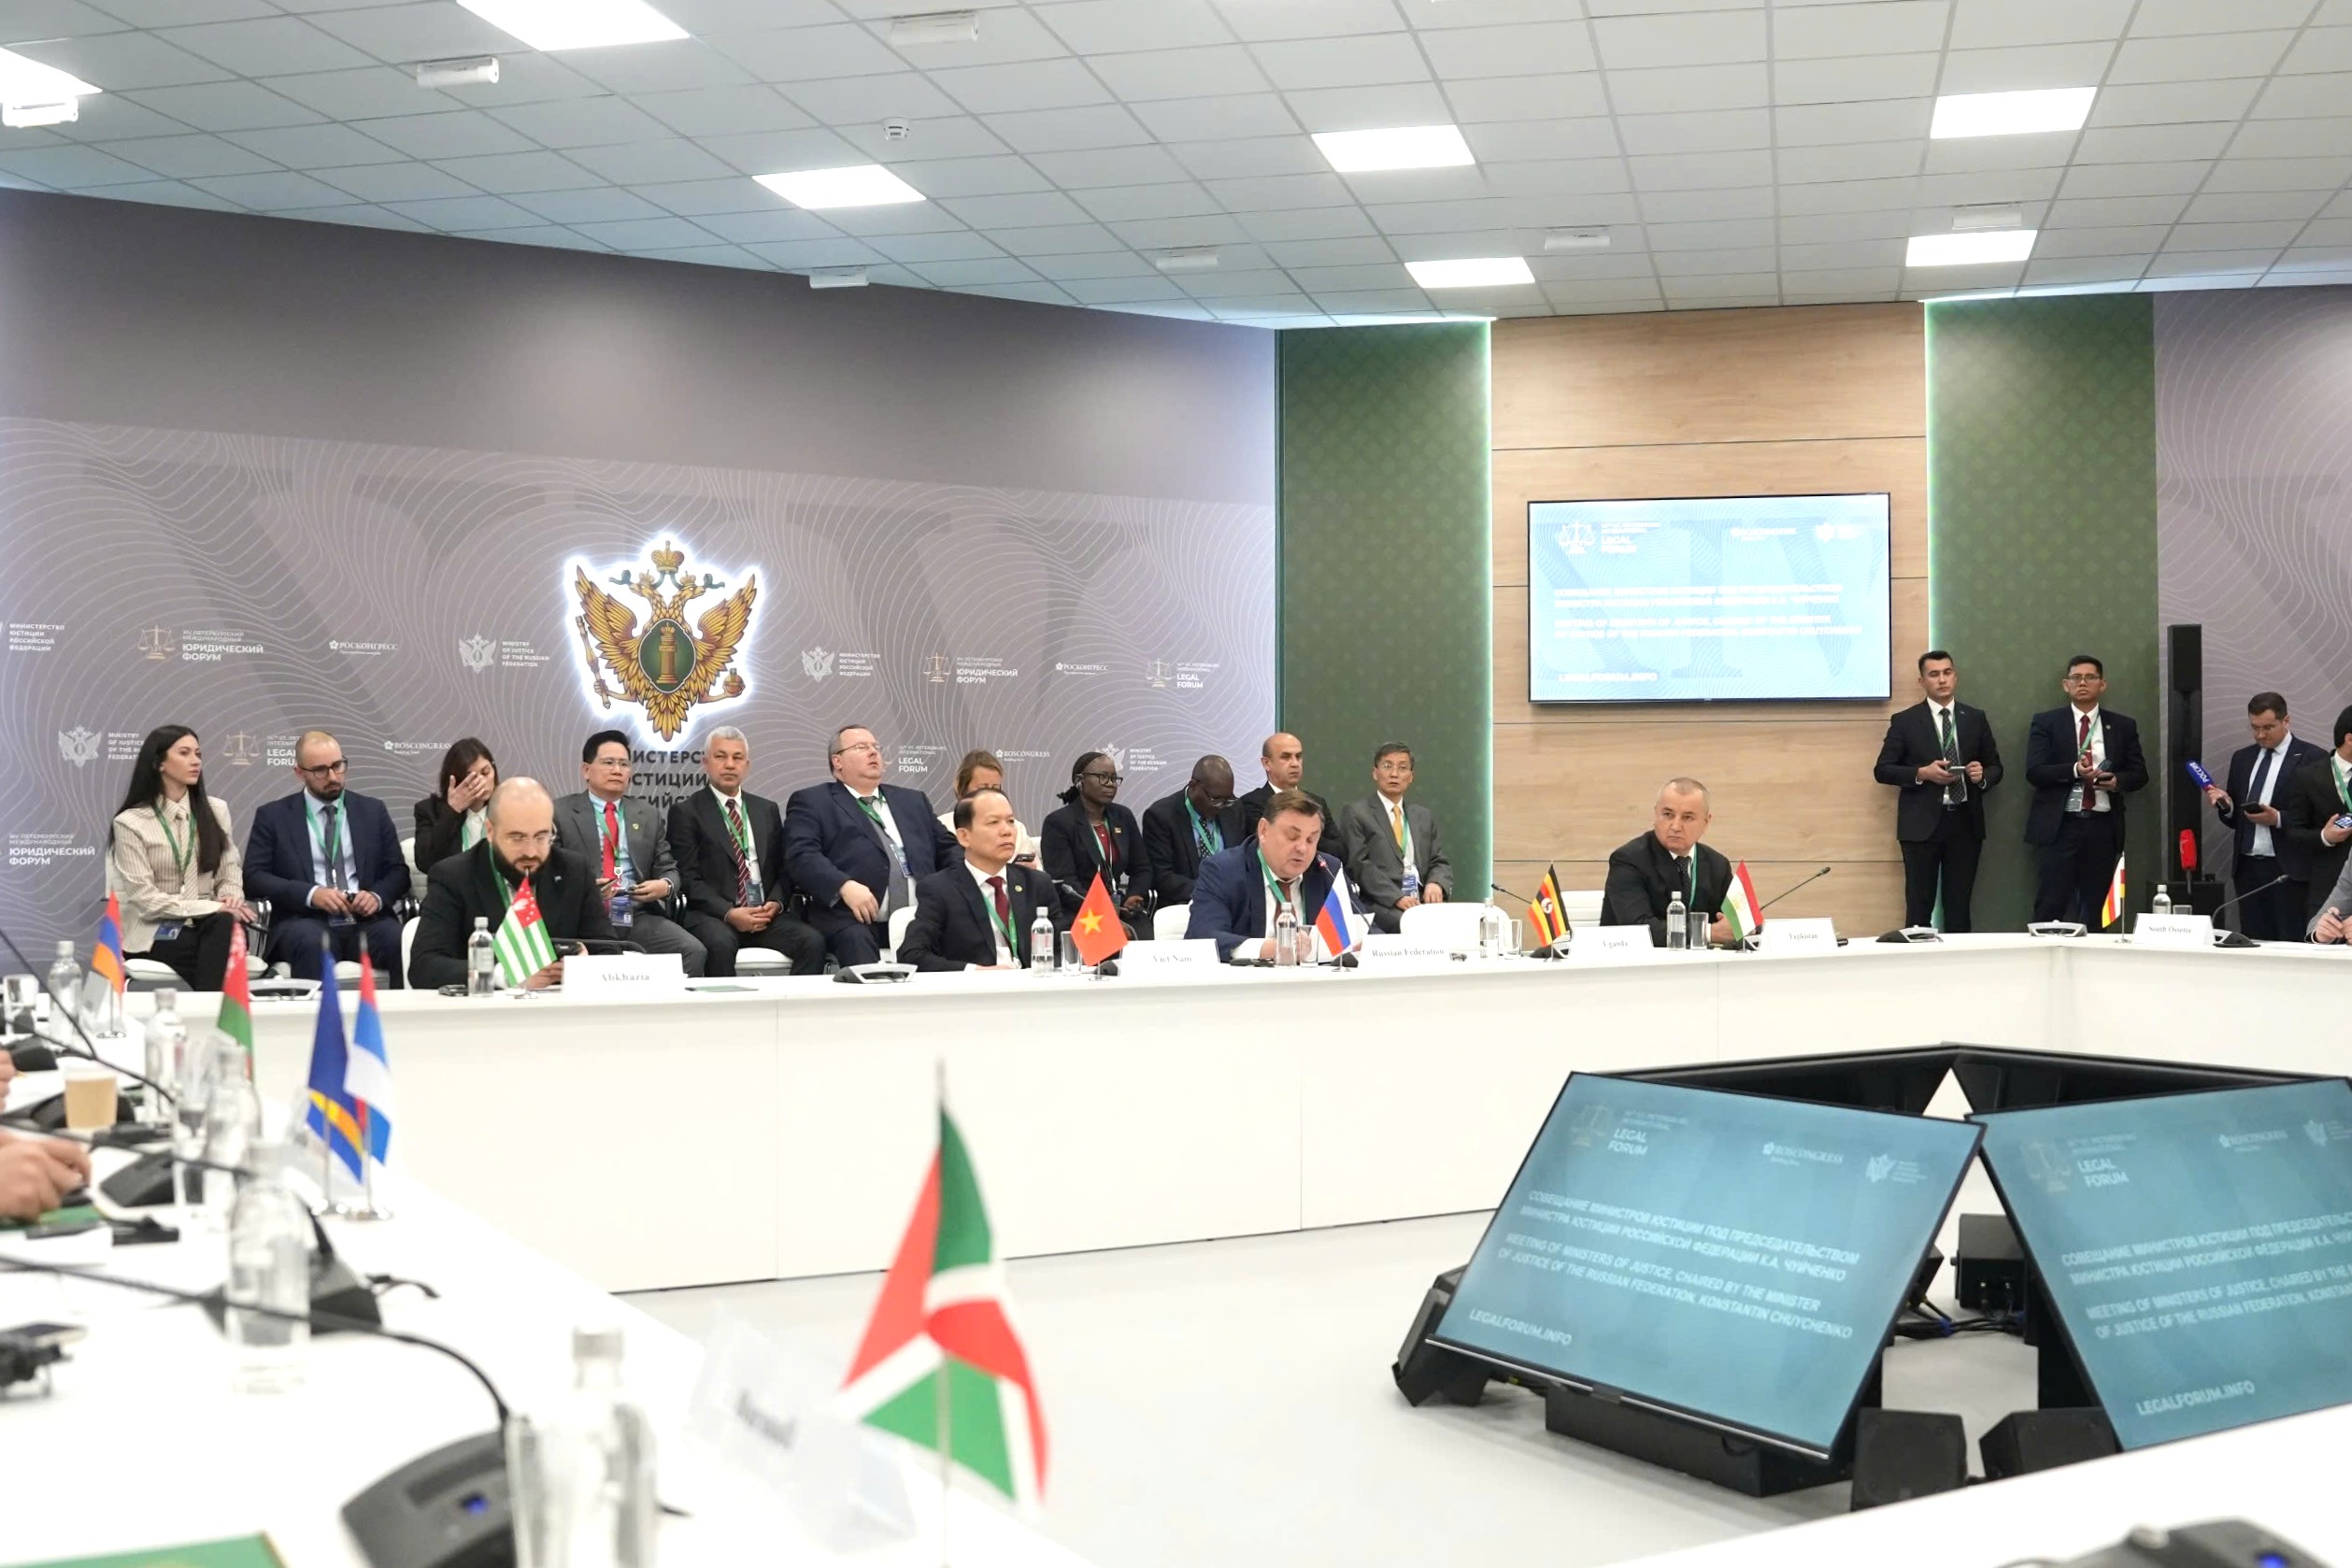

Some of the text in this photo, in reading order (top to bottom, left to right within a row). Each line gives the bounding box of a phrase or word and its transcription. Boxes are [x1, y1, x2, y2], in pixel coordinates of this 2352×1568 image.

[182, 643, 264, 653] ЮРИДИЧЕСКИЙ
[339, 642, 398, 650] РОСКОНГРЕСС
[182, 653, 221, 662] ФОРУМ
[957, 668, 1019, 677] ЮРИДИЧЕСКИЙ
[1176, 673, 1200, 681] LEGAL
[267, 758, 297, 766] FORU
[628, 773, 707, 788] СТИЦИИ
[9, 846, 95, 856] ЮРИДИЧЕСКИЙ
[9, 857, 50, 865] ФОРУМ
[1613, 1128, 1647, 1143] LEGAL
[1607, 1140, 1648, 1155] FORUM
[2076, 1158, 2117, 1173] LEGAL
[2084, 1171, 2130, 1188] FORUM
[1703, 1225, 1730, 1242] ПОД
[1728, 1230, 1860, 1265] ПРЕДСЕДАТЕЛЬСТВОМ
[1505, 1233, 1548, 1251] MEETING
[1547, 1241, 1563, 1254] OF
[1614, 1257, 1631, 1270] OF
[1674, 1270, 1724, 1290] CHAIRED
[1722, 1281, 1744, 1294] BY
[1742, 1284, 1766, 1301] THE
[1764, 1289, 1822, 1313] MINISTER
[1498, 1247, 1512, 1260] OF
[1511, 1250, 1551, 1269] JUSTICE
[1550, 1260, 1566, 1272] OF
[1565, 1262, 1587, 1277] THE
[1585, 1267, 1632, 1289] RUSSIAN
[1697, 1295, 1770, 1321] KONSTANTIN
[1769, 1310, 1854, 1339] CHUYCHENKO
[2135, 1297, 2150, 1312] OF
[2208, 1286, 2222, 1299] OF
[1469, 1307, 1572, 1346] LEGALFORUM.INFO
[2095, 1324, 2111, 1340] OF
[2113, 1316, 2159, 1337] JUSTICE
[2158, 1314, 2173, 1329] OF
[2174, 1308, 2199, 1325] THE
[2135, 1379, 2255, 1416] LEGALFORUM.INFO
